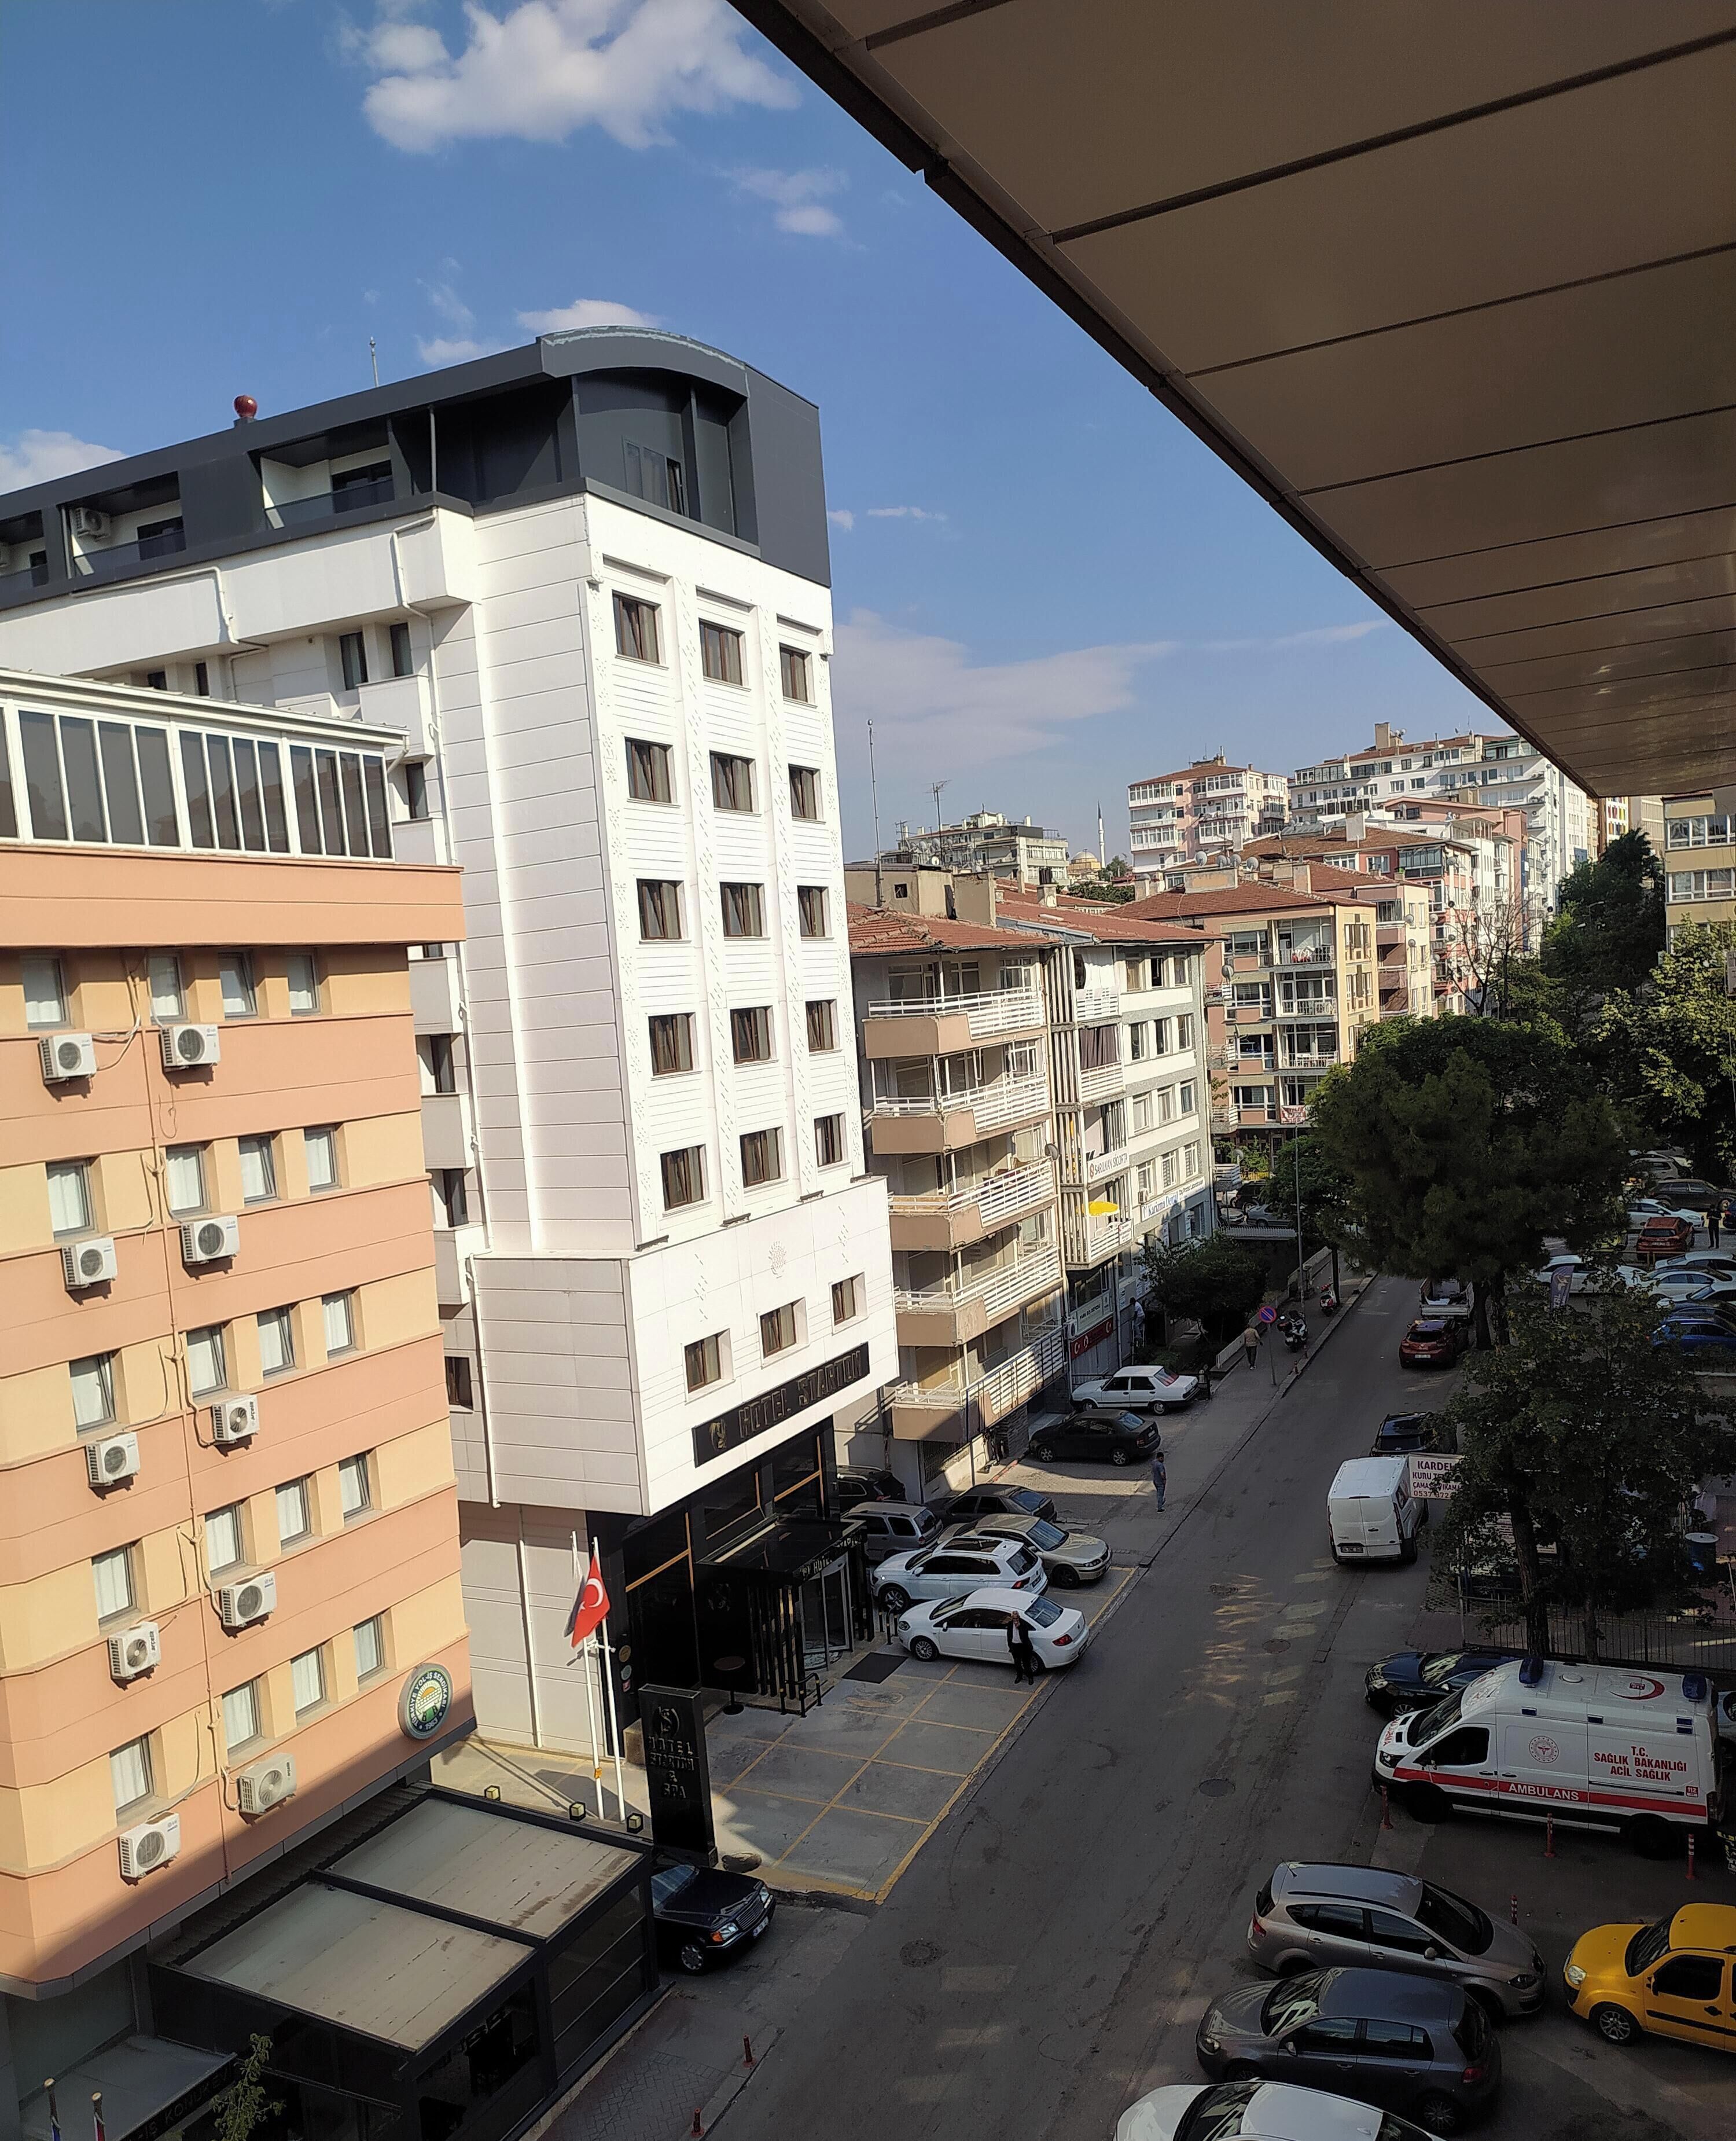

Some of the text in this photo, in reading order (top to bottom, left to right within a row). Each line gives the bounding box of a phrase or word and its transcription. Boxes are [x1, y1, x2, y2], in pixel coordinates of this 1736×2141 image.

[1149, 1191, 1178, 1217] Karizma Dental
[738, 1350, 861, 1439] HOTEL STARTON
[1417, 1460, 1454, 1471] KARDEL
[1413, 1471, 1432, 1480] KURU
[409, 1692, 418, 1726] TÜRKİYE
[433, 1672, 448, 1708] SENDİKASI
[649, 1736, 693, 1756] HOTEL
[1631, 1746, 1649, 1757] T.C.
[1594, 1752, 1687, 1772] SAĞLIK BAKANLIĞI
[1610, 1765, 1671, 1781] ACİL SAĞLIK
[1509, 1783, 1579, 1801] AMBULANS
